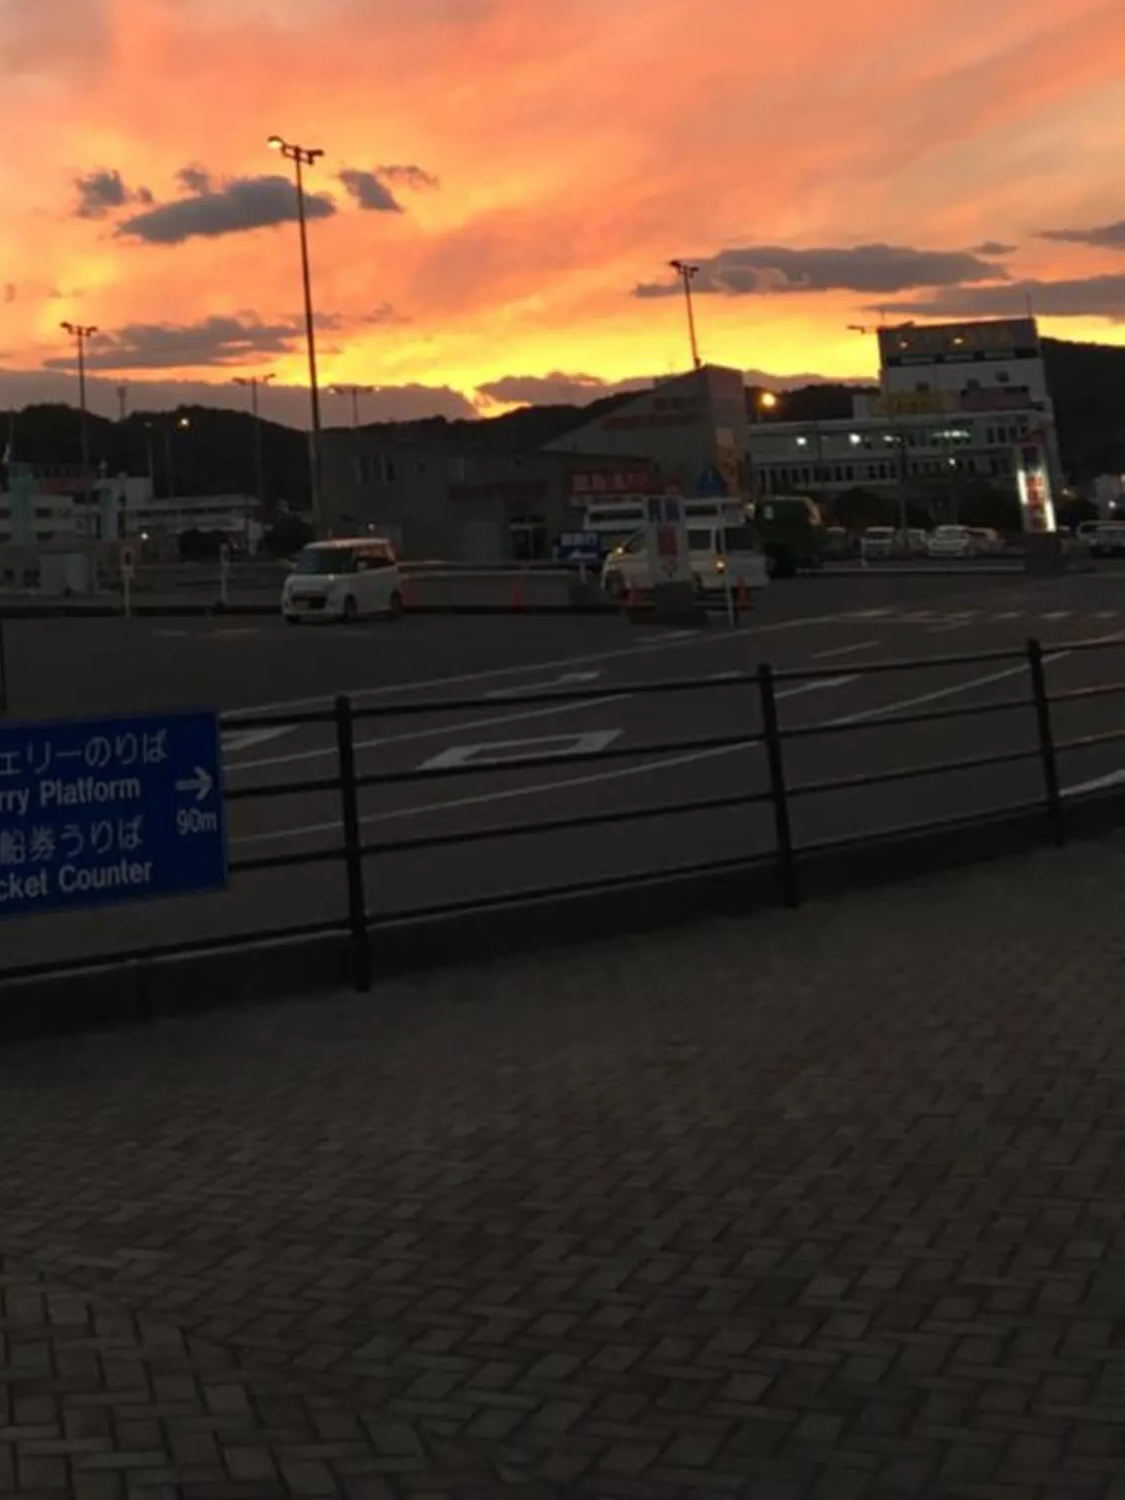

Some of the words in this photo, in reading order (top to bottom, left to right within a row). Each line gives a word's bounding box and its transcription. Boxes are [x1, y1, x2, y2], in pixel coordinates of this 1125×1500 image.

[39, 775, 141, 808] Platform
[175, 807, 218, 836] 90m
[58, 857, 154, 893] Counter
